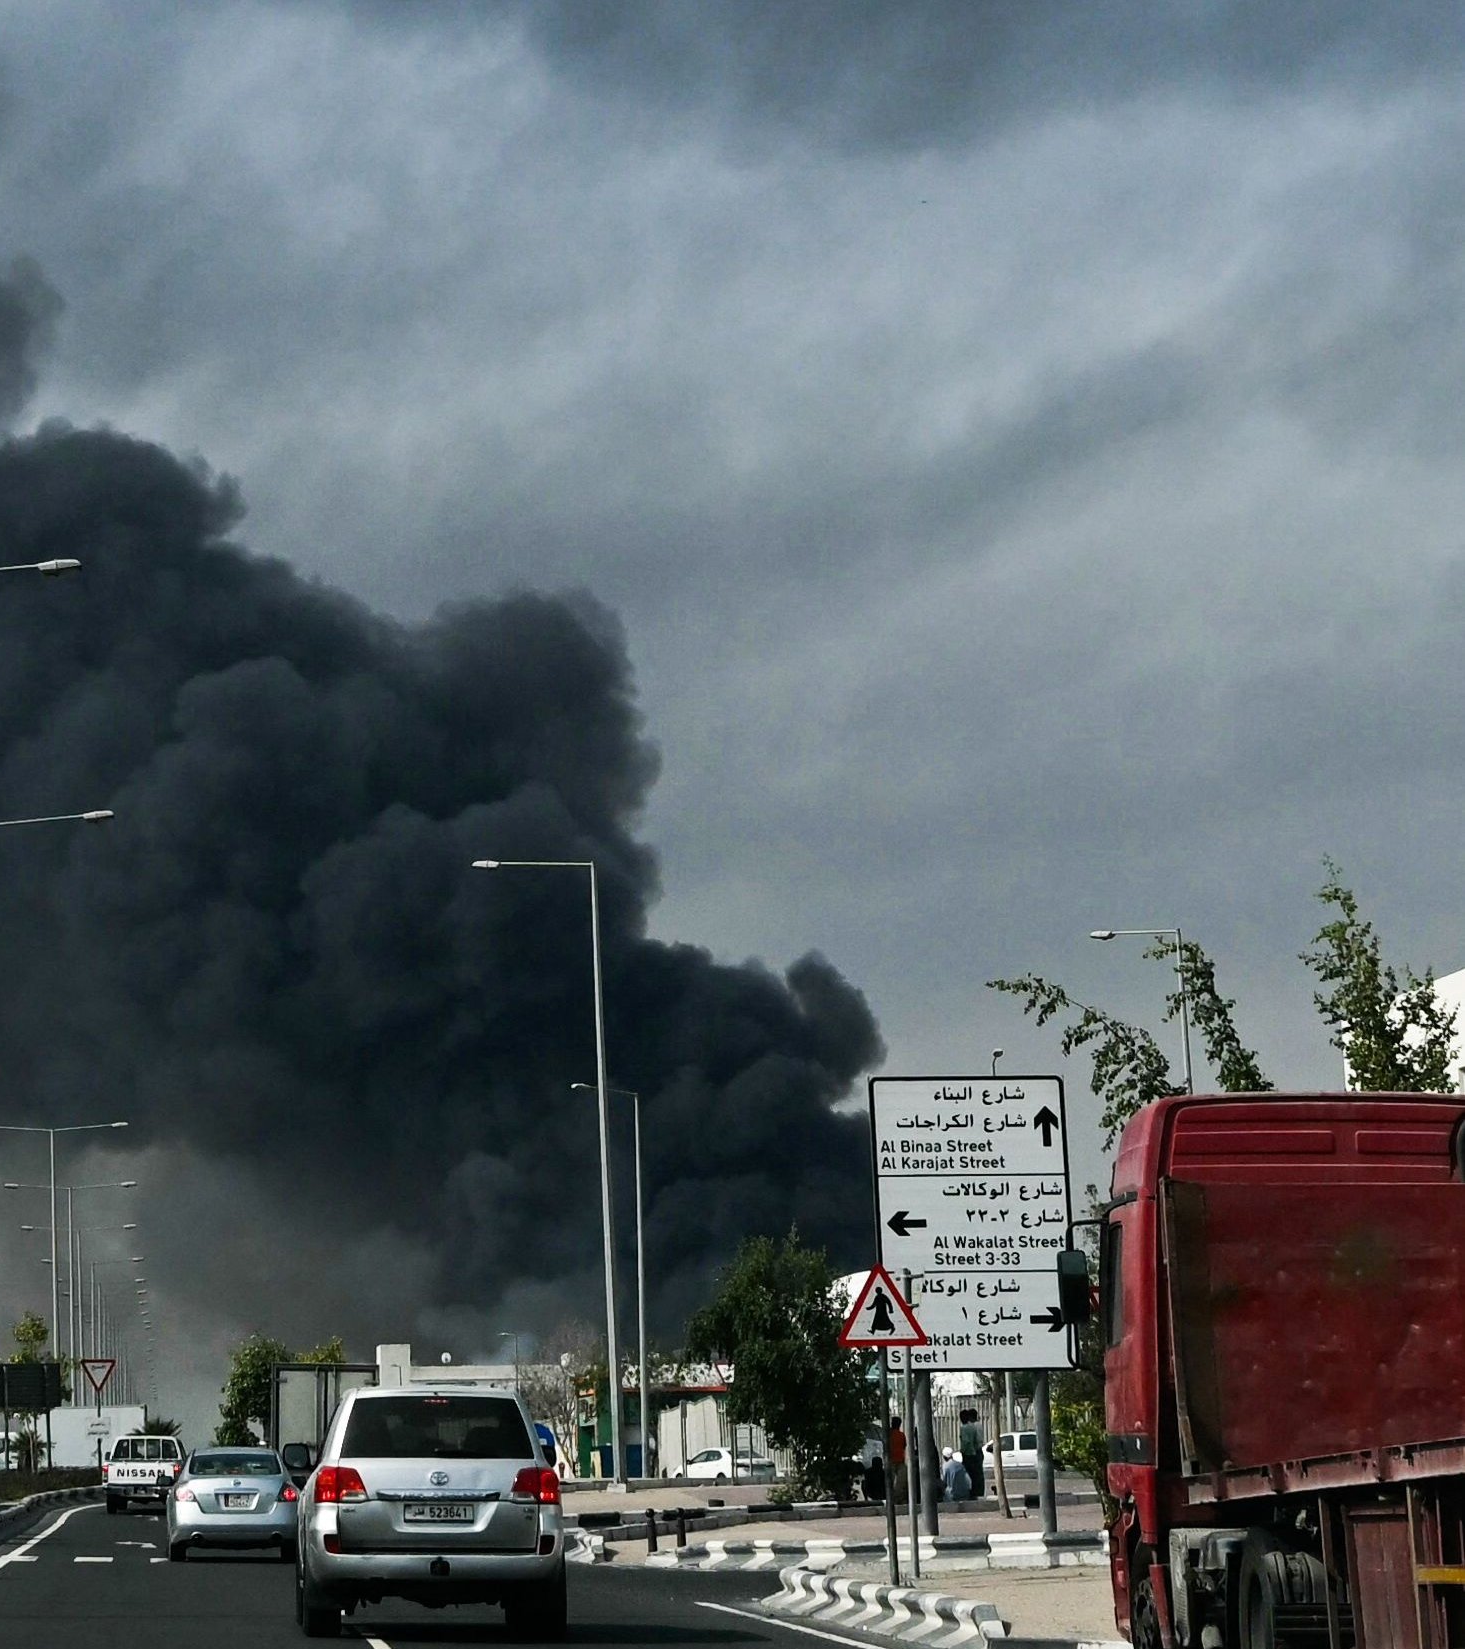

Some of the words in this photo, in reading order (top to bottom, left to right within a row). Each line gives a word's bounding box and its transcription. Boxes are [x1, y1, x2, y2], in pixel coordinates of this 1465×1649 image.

[934, 1087, 972, 1104] البناء
[982, 1087, 1024, 1105] شارع
[897, 1114, 973, 1131] الكراجات
[984, 1114, 1026, 1133] شارع
[881, 1141, 895, 1154] Al
[901, 1140, 941, 1154] Binaa
[947, 1140, 992, 1153] Street
[882, 1157, 896, 1170] Al
[902, 1156, 954, 1172] Karajat
[960, 1156, 1005, 1169] Street
[943, 1182, 1009, 1199] الوكالات
[1020, 1182, 1062, 1201] شارع
[1021, 1209, 1064, 1228] شارع
[934, 1236, 949, 1249] Al
[954, 1236, 1014, 1249] Wakalat
[1019, 1236, 1064, 1249] Street
[935, 1253, 981, 1266] Street
[986, 1252, 1020, 1266] 3-33
[922, 1279, 968, 1297] الوكالا
[977, 1279, 1020, 1298] شارع
[979, 1307, 1021, 1326] شارع
[926, 1333, 971, 1347] akalat
[977, 1333, 1022, 1346] Street
[942, 1350, 948, 1363] 1
[117, 1469, 165, 1477] NISSAN
[429, 1504, 467, 1518] 523641
